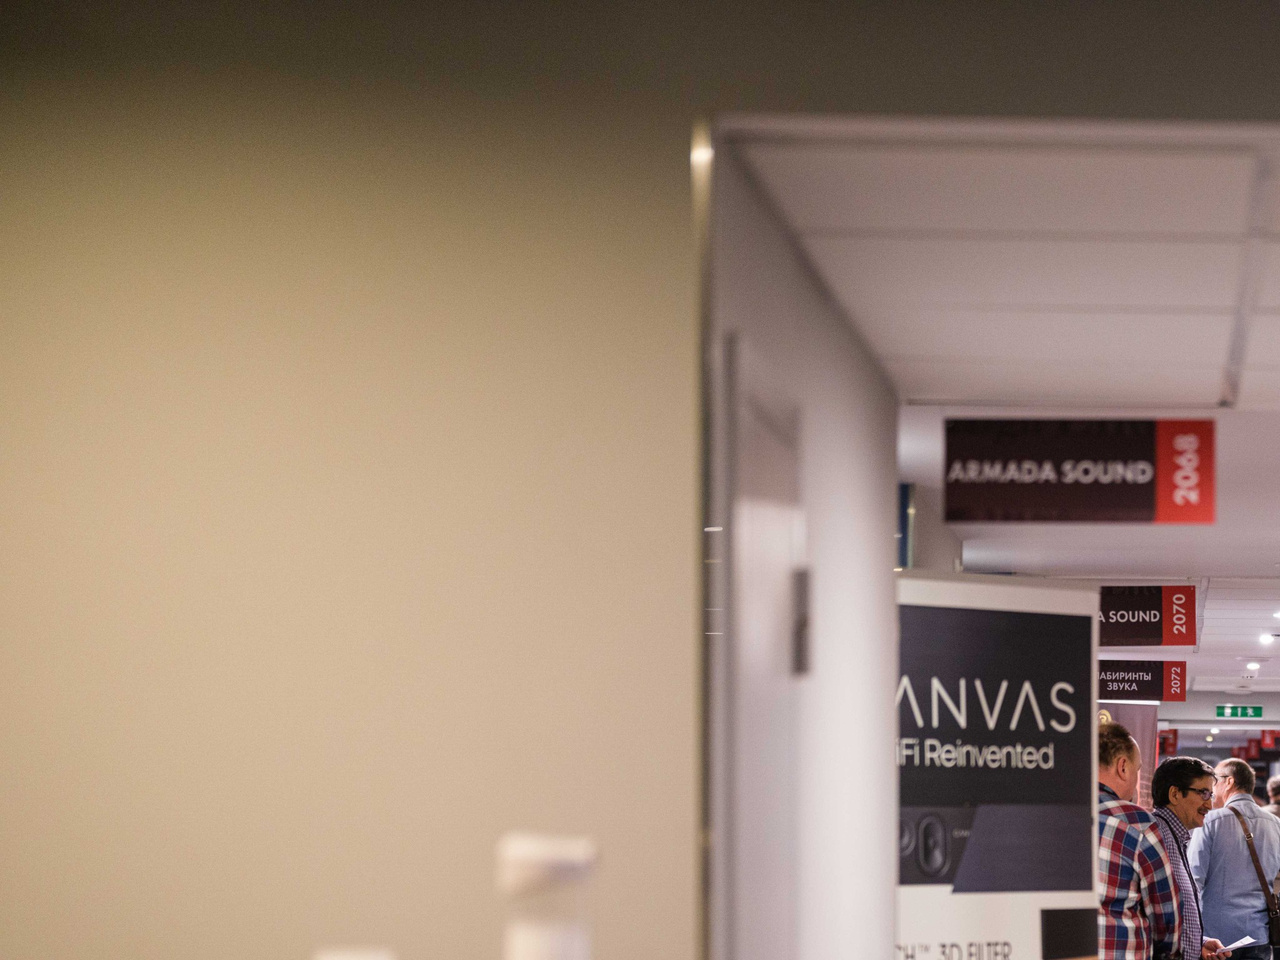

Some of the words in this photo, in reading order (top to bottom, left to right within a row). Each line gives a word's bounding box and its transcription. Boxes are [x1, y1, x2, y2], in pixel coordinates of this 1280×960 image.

[948, 460, 1058, 485] ARMADA
[1060, 460, 1155, 485] SOUND
[1172, 433, 1200, 506] 2068
[1109, 611, 1160, 622] SOUND
[1173, 594, 1186, 633] 2070
[1107, 683, 1138, 691] ЗВУКА
[1172, 667, 1181, 694] 2072
[924, 738, 1055, 770] Reinvented
